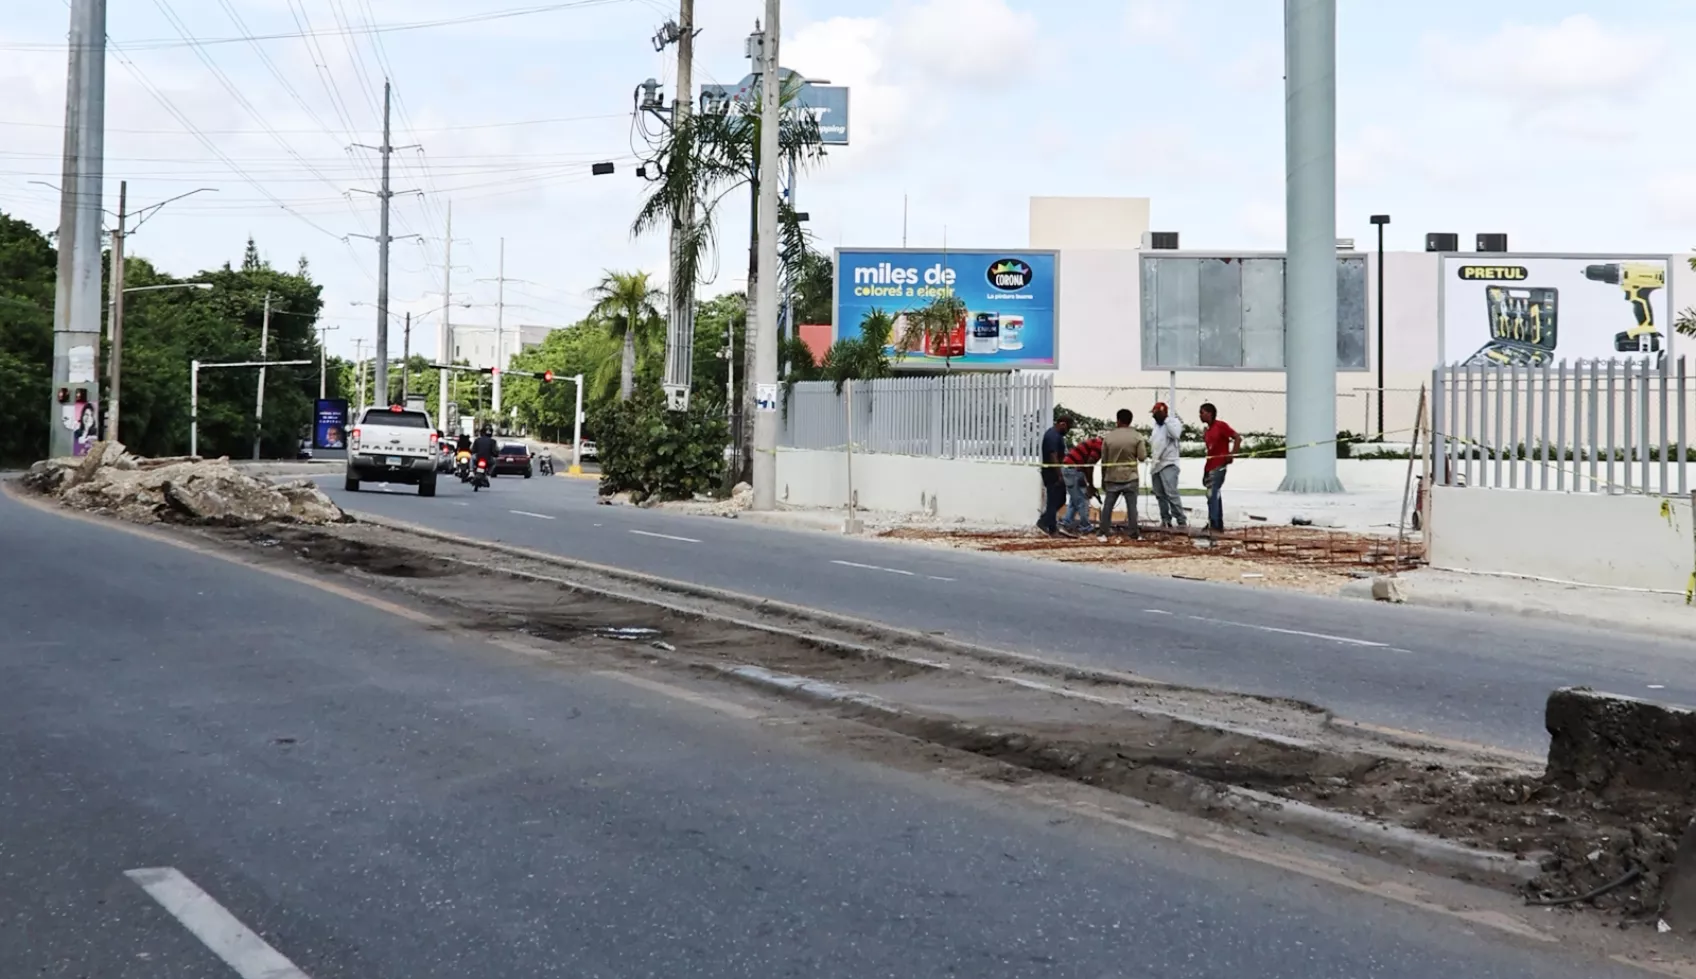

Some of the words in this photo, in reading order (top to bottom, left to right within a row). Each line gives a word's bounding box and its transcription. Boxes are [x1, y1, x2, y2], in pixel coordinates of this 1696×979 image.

[855, 263, 918, 284] miles
[924, 263, 956, 284] de
[1464, 267, 1525, 279] PRETUL
[995, 274, 1024, 286] CORONA
[854, 285, 903, 297] colores
[905, 287, 914, 297] a
[917, 285, 955, 299] elegir
